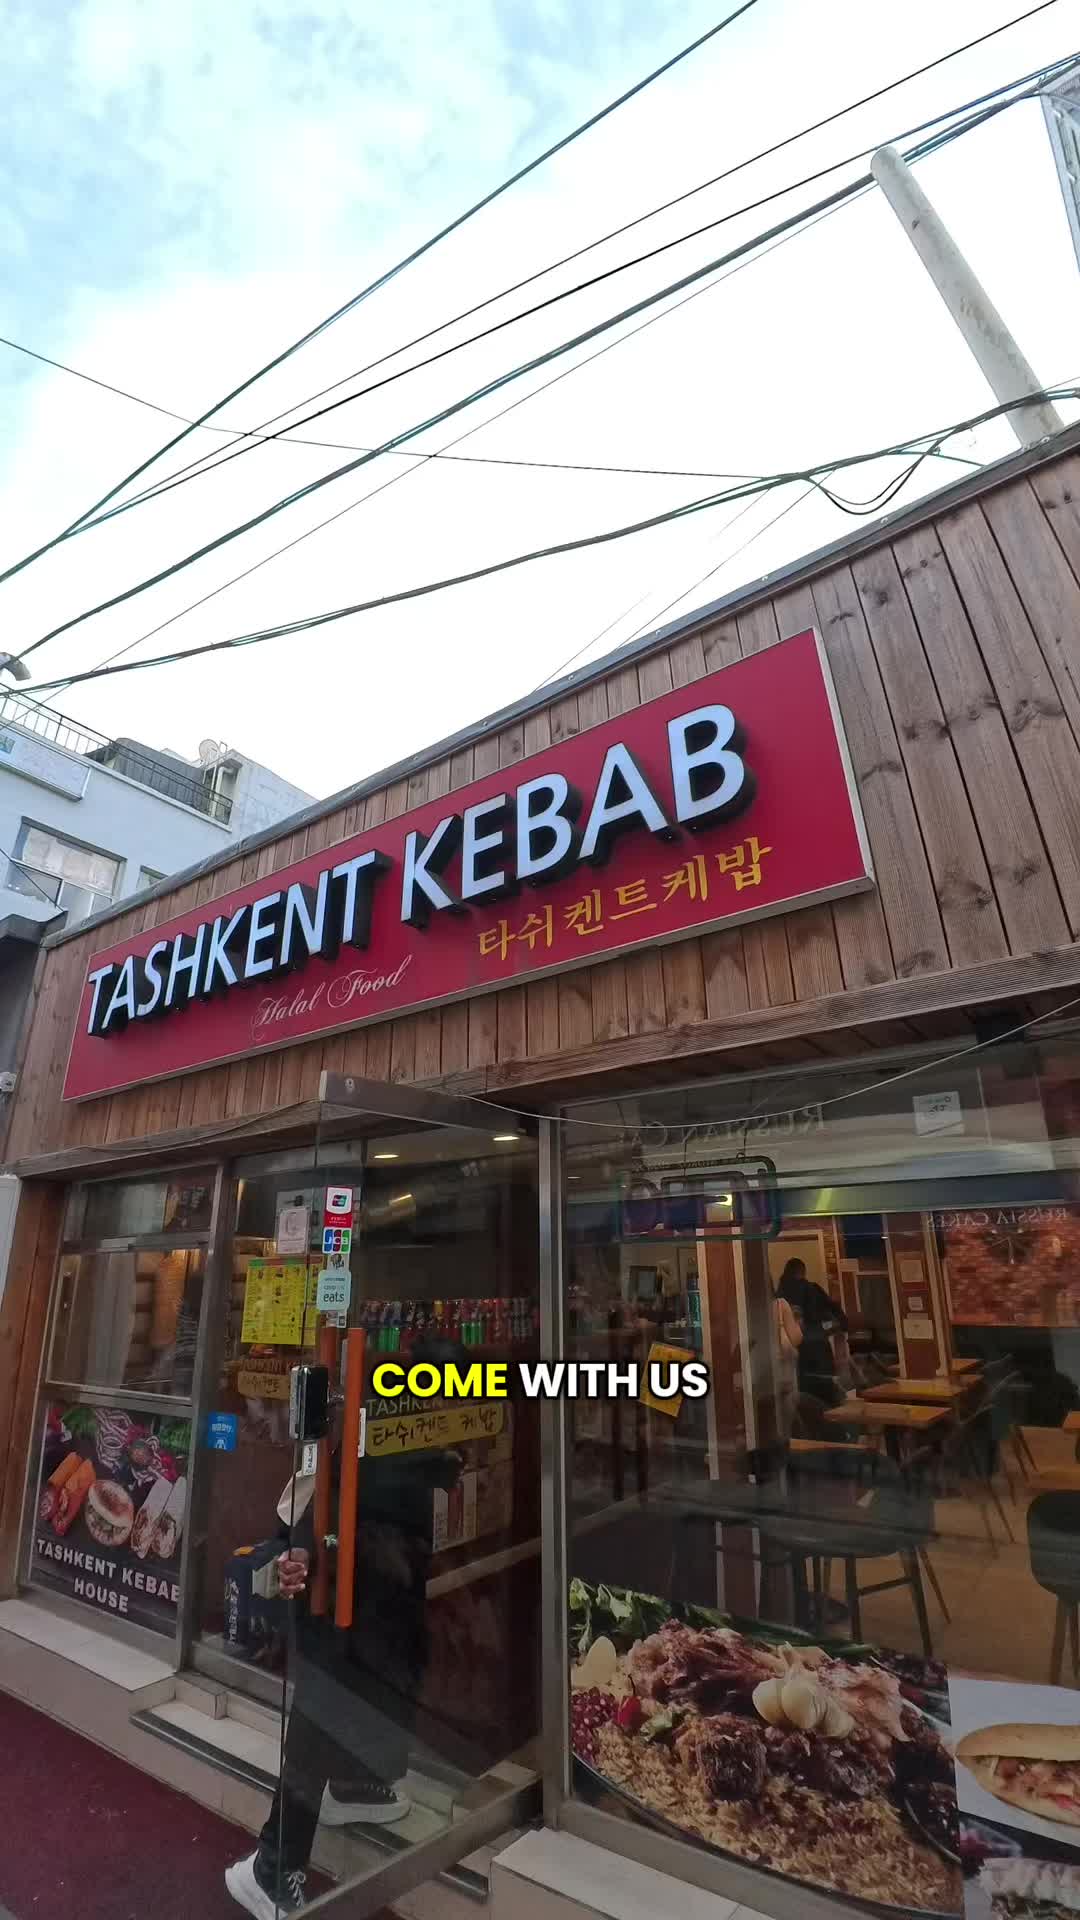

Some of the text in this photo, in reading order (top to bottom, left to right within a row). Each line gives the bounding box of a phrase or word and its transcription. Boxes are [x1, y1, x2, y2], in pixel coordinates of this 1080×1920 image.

[86, 703, 749, 1035] TASHKENT KEBAB
[251, 954, 413, 1041] Halal Food
[323, 1292, 345, 1303] eats
[37, 1539, 117, 1579] TASHKENT
[74, 1577, 130, 1613] HOUSE
